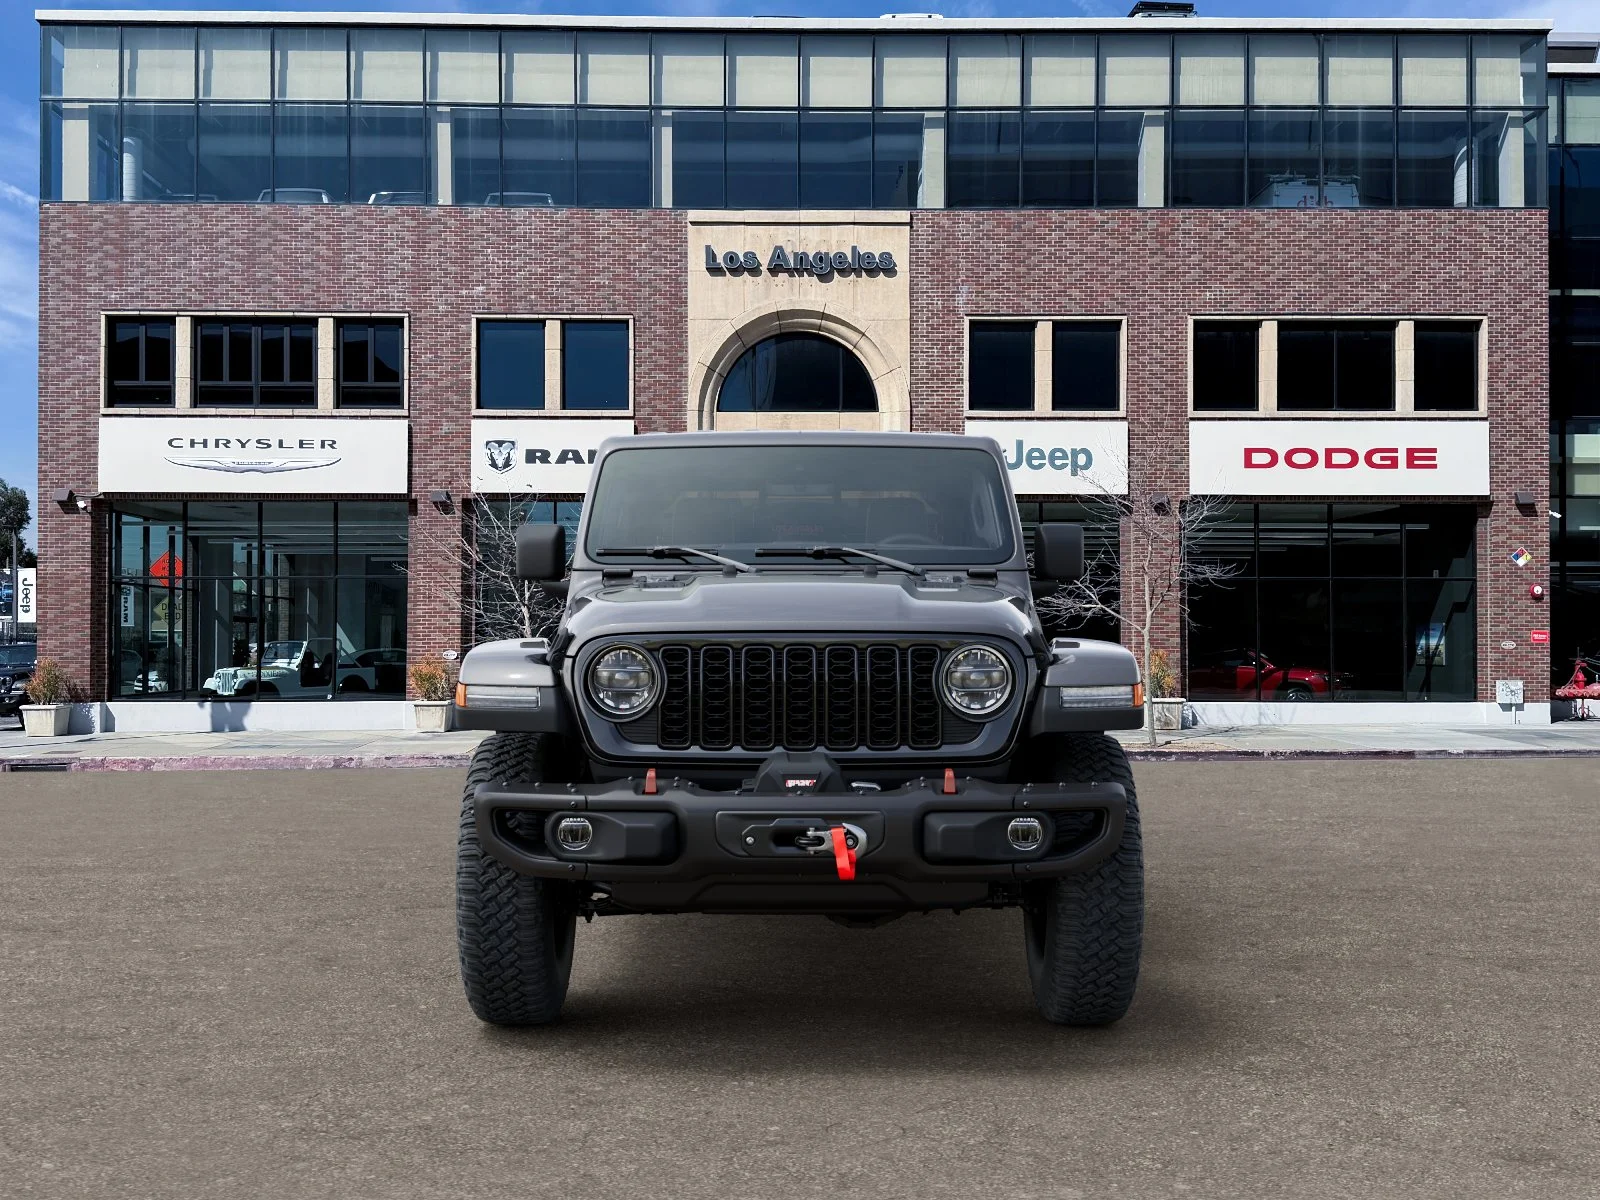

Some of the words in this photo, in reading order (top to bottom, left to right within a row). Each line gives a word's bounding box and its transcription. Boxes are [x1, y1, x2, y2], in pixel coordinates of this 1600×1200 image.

[1296, 195, 1334, 208] dih
[704, 244, 760, 271] Los
[767, 245, 896, 276] Angeles
[167, 437, 338, 450] CHRYSLER
[1004, 438, 1094, 477] Jeep
[1243, 447, 1438, 470] DODGE
[20, 577, 34, 614] Jeep
[164, 612, 181, 620] ED
